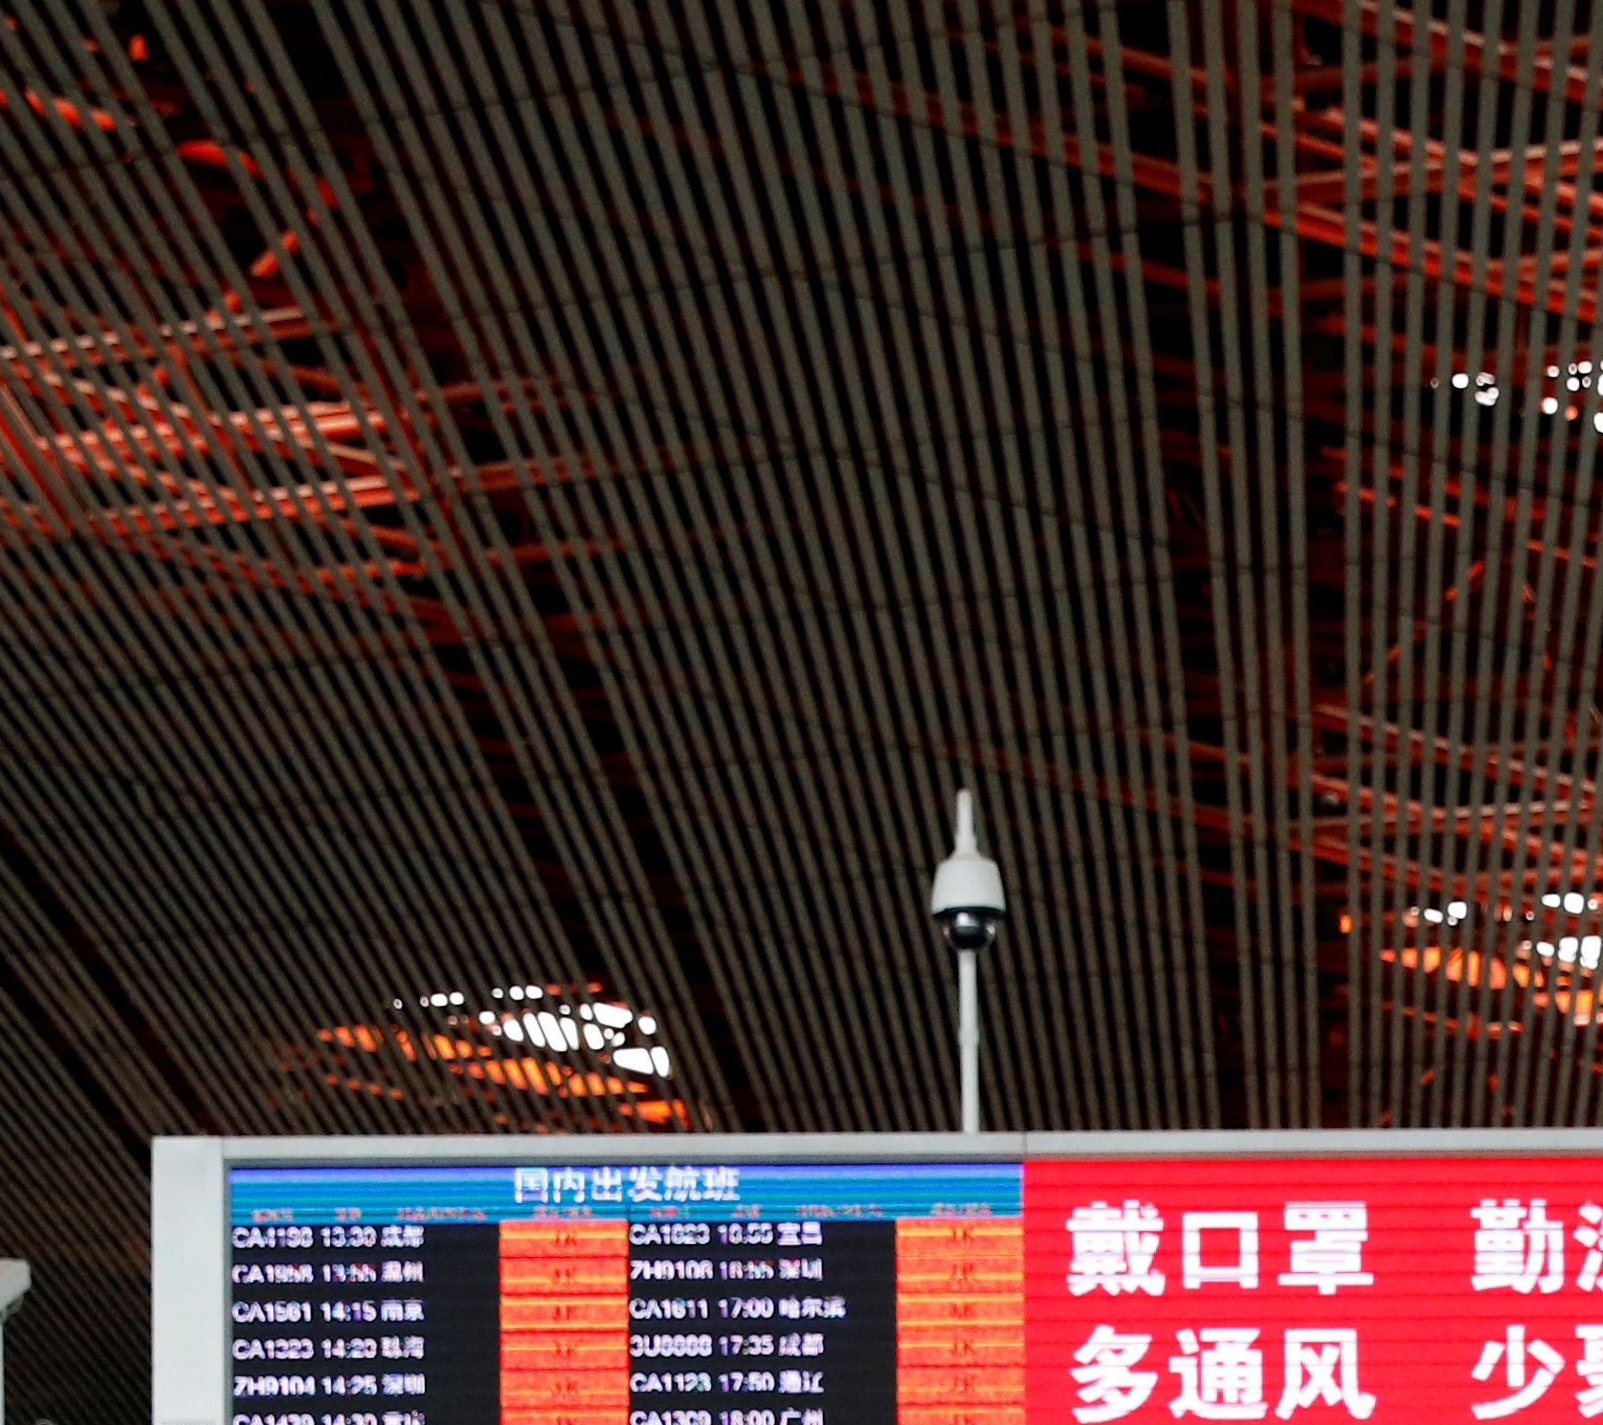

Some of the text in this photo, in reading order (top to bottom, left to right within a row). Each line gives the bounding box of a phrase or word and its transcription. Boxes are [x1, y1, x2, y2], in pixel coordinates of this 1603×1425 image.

[514, 1166, 739, 1203] 国内出发航班
[1066, 1199, 1374, 1296] 戴口罩
[321, 1301, 376, 1321] 14:15
[719, 1298, 774, 1318] 17:00
[322, 1338, 377, 1358] 14:20
[720, 1335, 774, 1355] 17:35
[1070, 1324, 1376, 1424] 多通风
